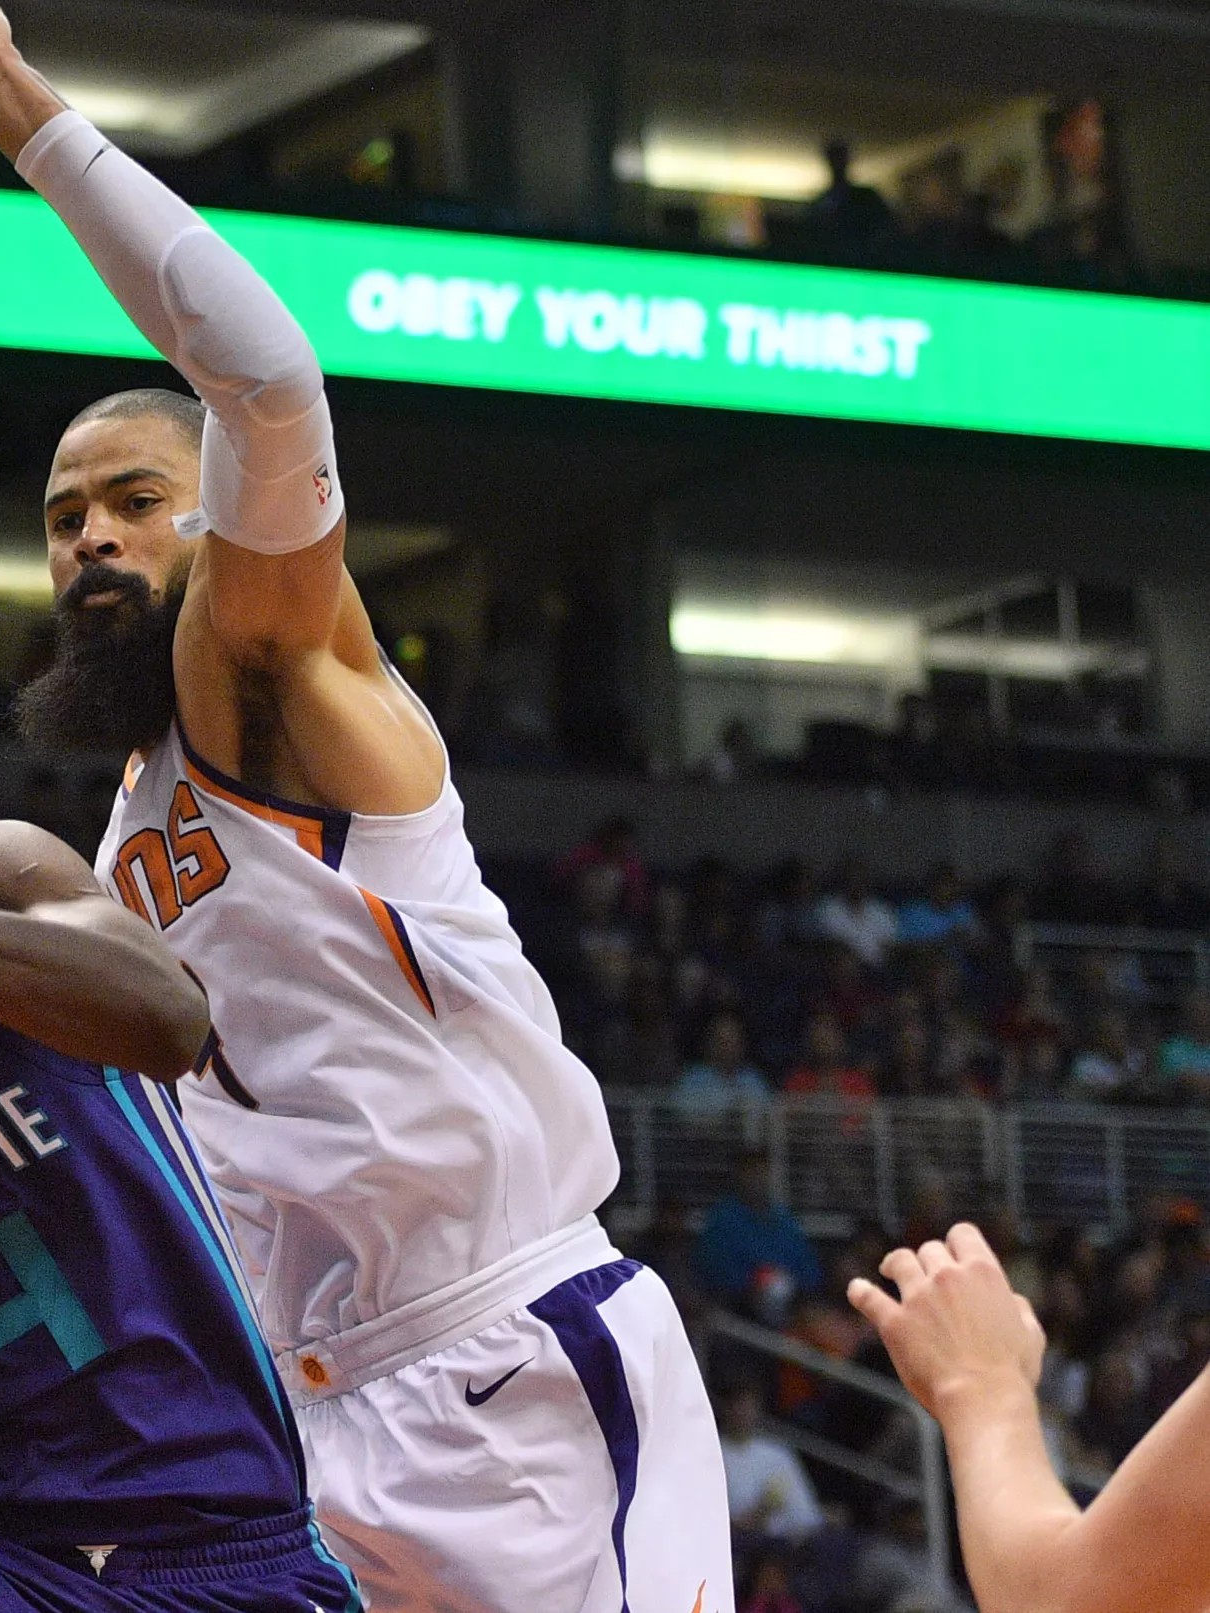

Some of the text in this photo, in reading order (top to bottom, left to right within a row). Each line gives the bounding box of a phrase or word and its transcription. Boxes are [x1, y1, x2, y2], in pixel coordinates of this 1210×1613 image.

[348, 270, 931, 377] OBEY YOUR THIRST
